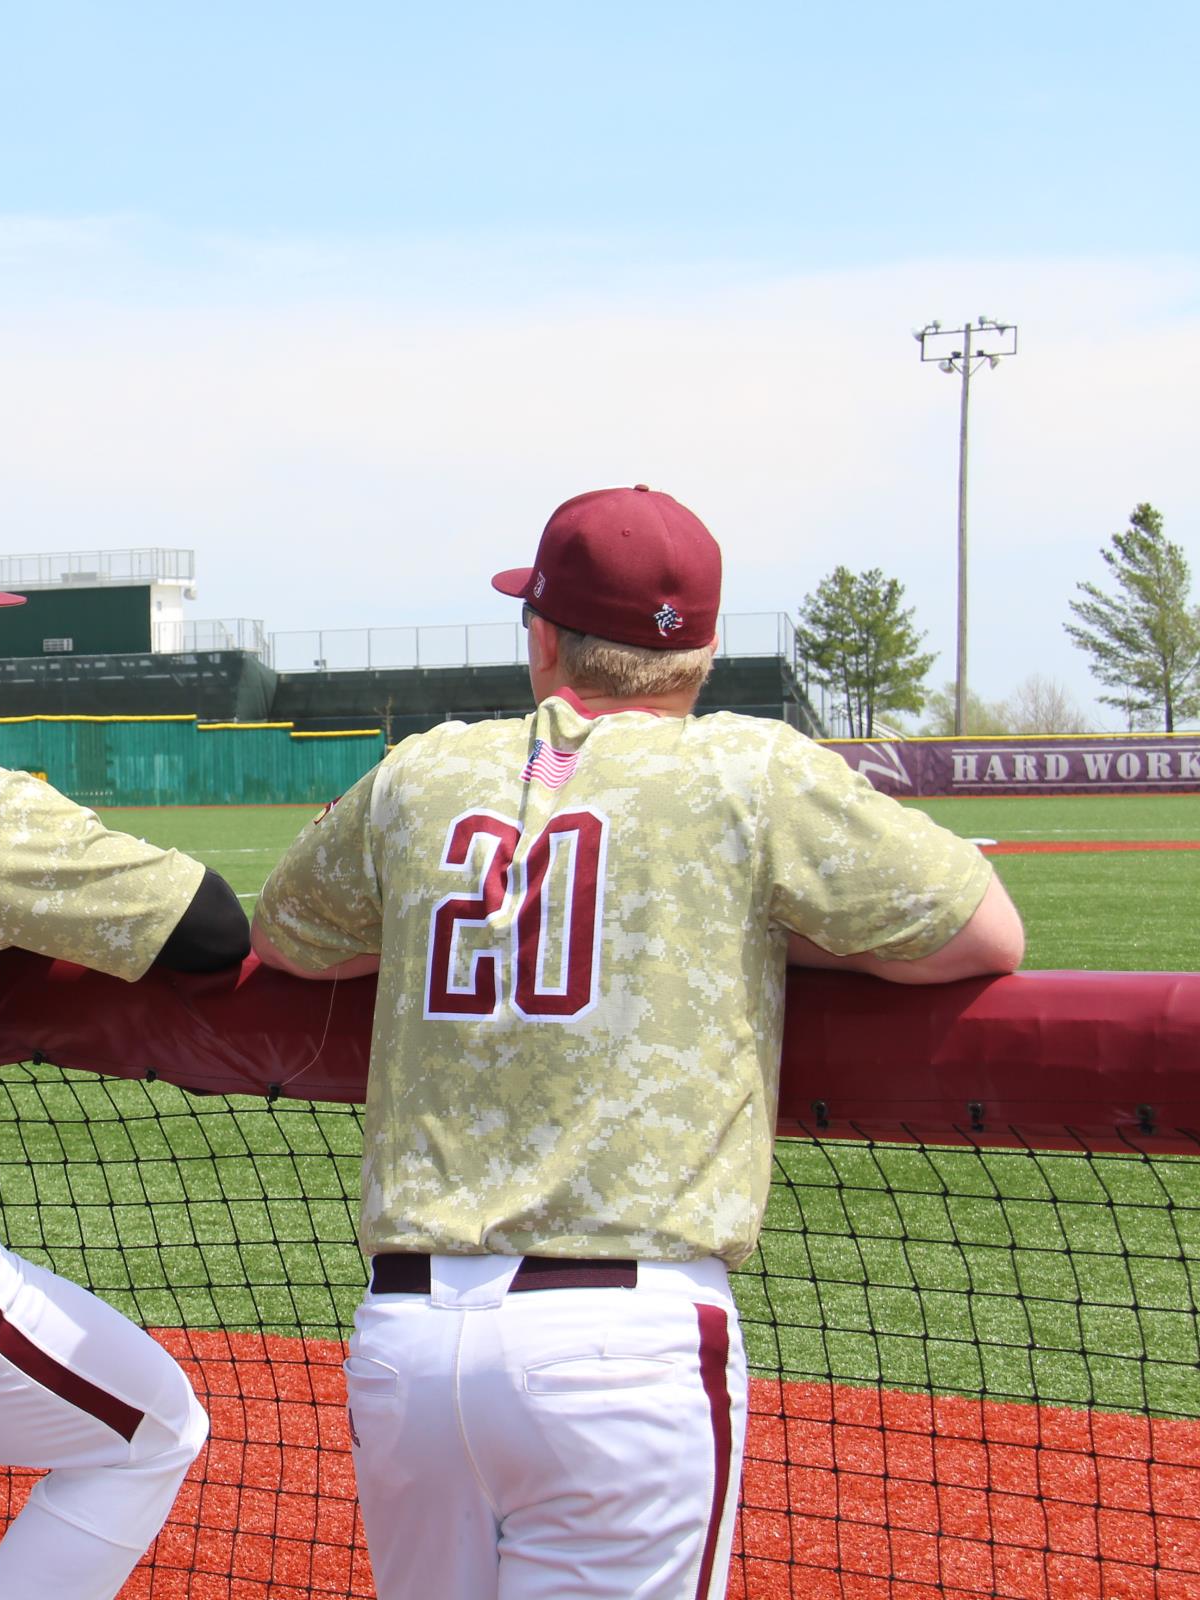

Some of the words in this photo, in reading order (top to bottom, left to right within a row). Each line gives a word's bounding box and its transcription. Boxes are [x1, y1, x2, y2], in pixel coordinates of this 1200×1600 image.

[952, 753, 1069, 782] HARD
[1082, 752, 1200, 780] WORK
[424, 807, 609, 1023] 20
